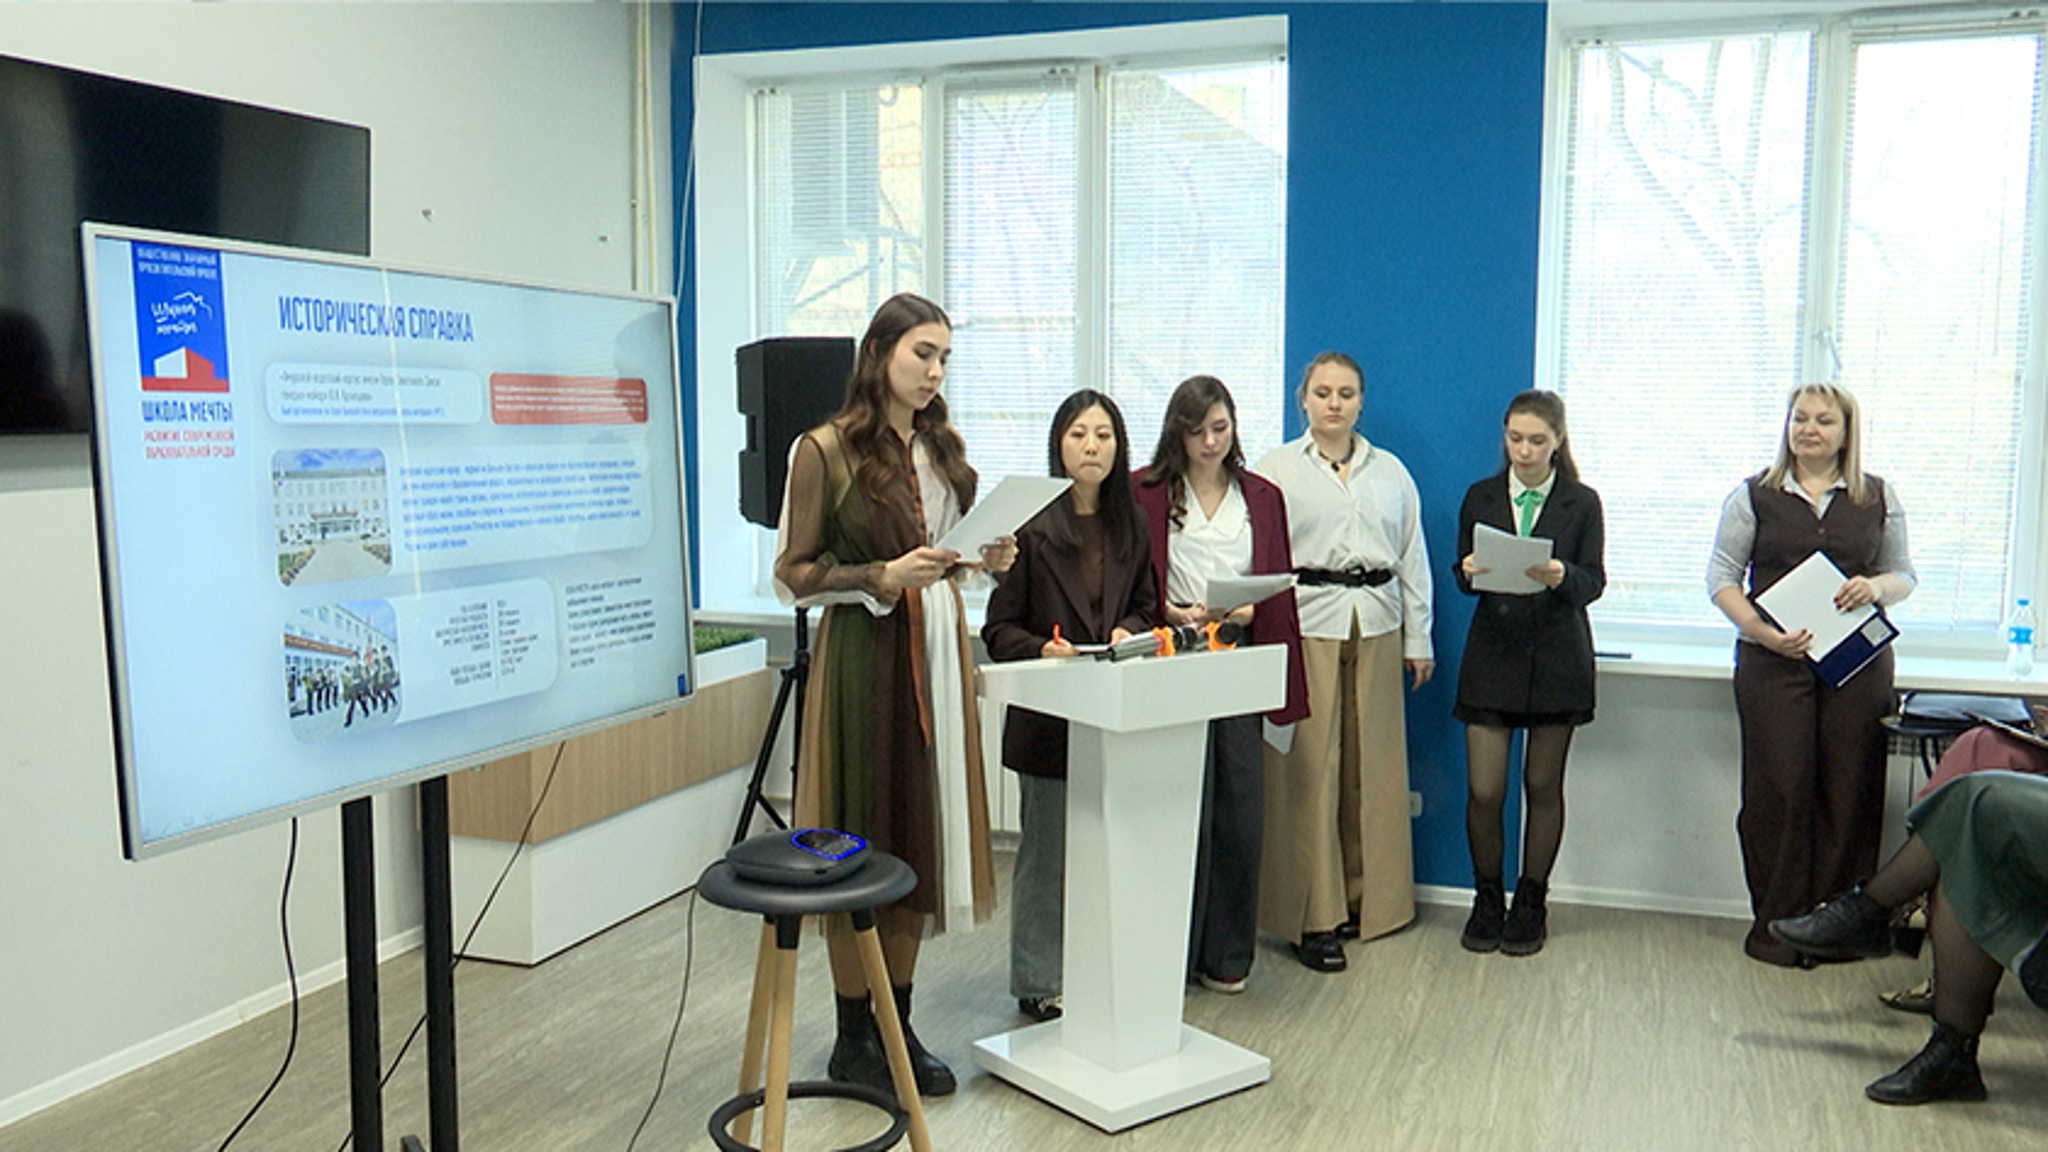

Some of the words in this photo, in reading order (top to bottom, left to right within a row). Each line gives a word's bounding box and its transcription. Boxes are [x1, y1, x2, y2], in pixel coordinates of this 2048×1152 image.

[278, 296, 406, 337] ИСТОРИЧЕСКАЯ
[409, 306, 474, 342] СПРАВКА
[141, 400, 188, 422] ШКОЛА
[190, 401, 233, 422] МЕЧТЫ
